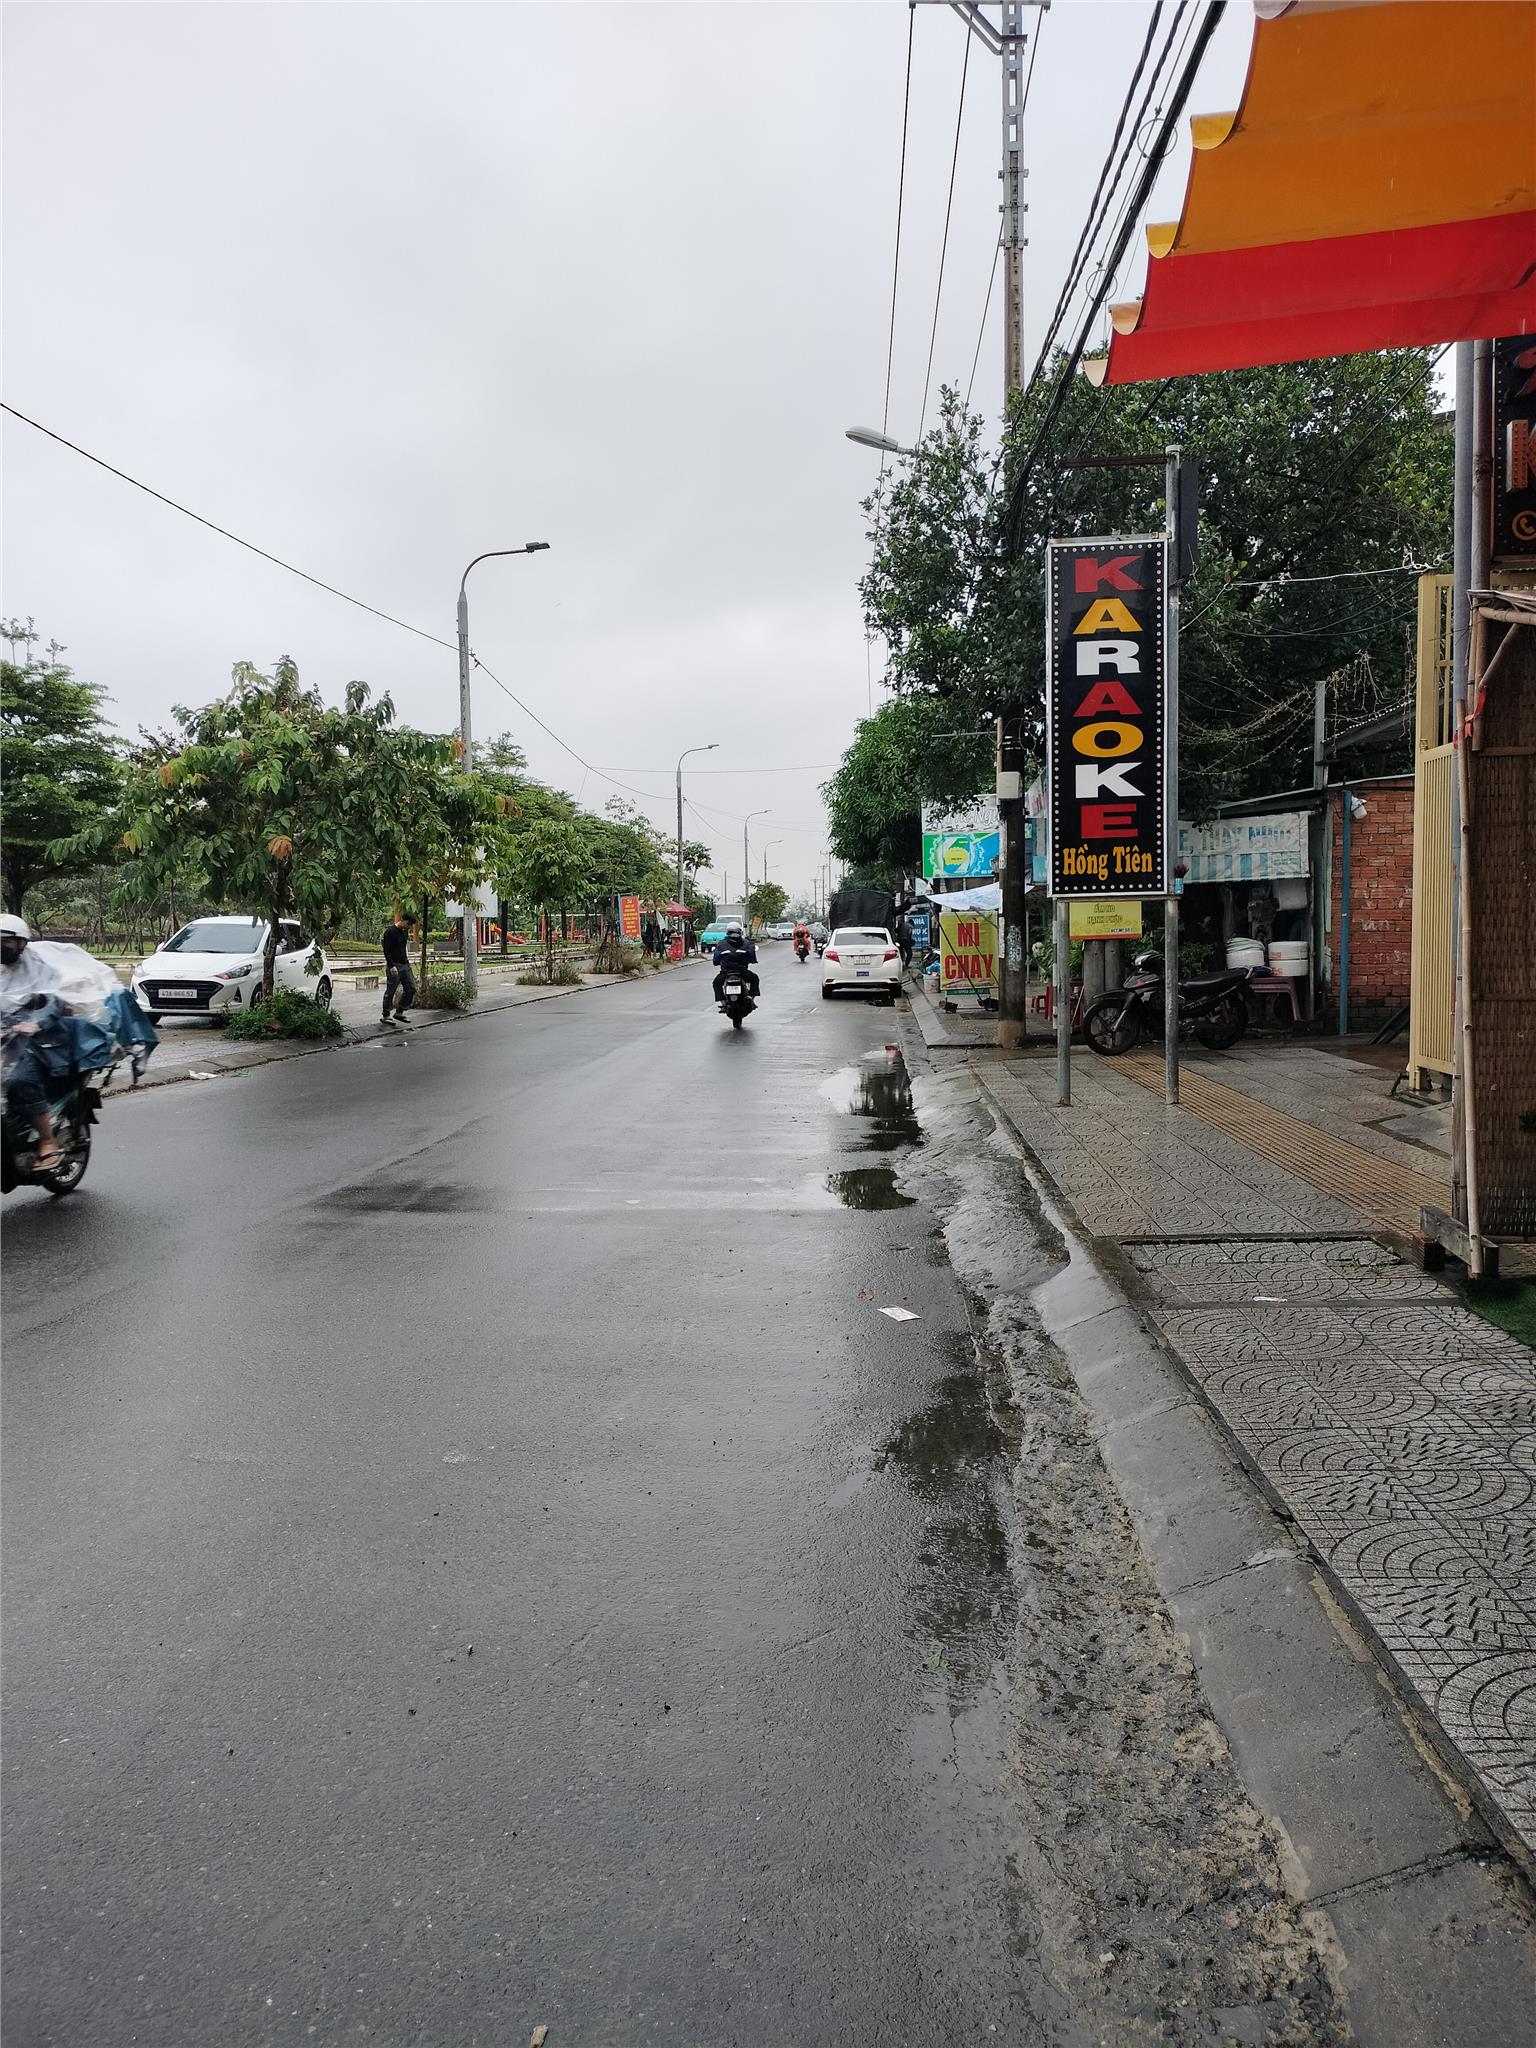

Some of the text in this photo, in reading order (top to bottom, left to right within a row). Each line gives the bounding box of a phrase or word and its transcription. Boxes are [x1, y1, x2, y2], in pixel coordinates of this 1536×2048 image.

[1072, 555, 1146, 840] KARAOKE
[1062, 843, 1153, 881] Hồng Tiên
[957, 917, 980, 947] MÌ
[944, 954, 994, 980] CHAY
